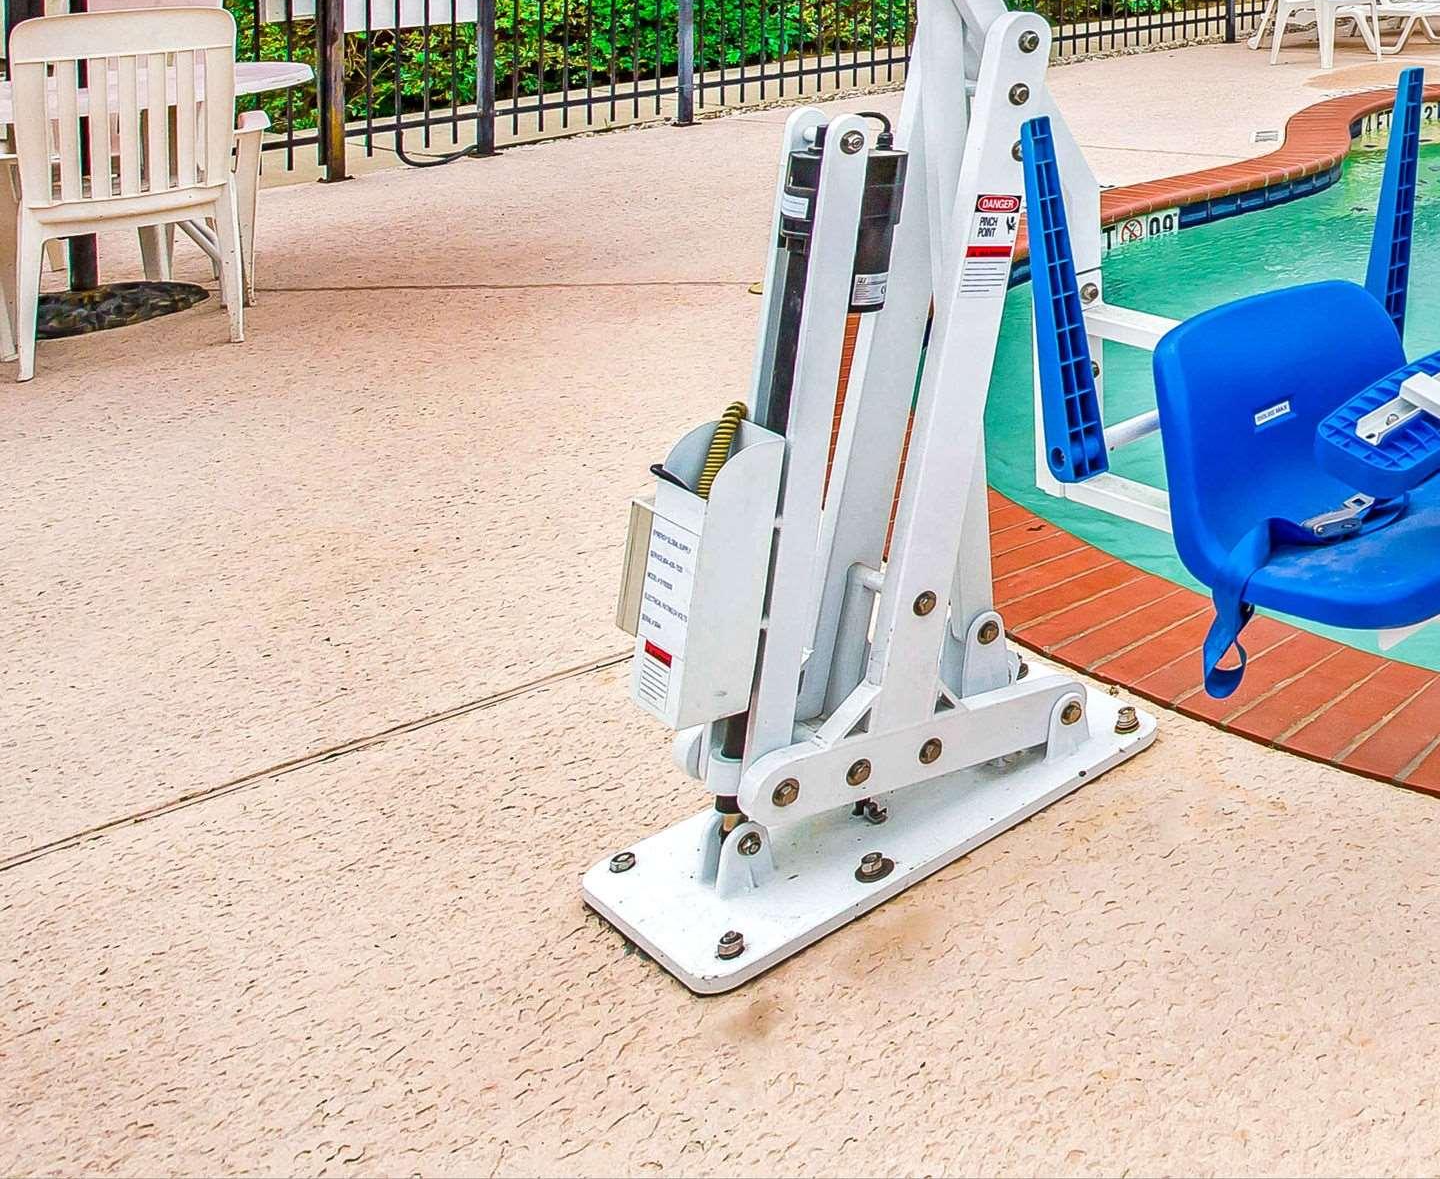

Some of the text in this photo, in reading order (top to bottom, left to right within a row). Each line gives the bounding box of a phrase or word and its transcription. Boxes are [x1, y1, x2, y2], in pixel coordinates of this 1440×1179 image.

[1377, 109, 1392, 129] FT
[982, 198, 1015, 209] DANGER
[979, 216, 998, 227] PINCH
[977, 227, 996, 238] POINT
[1102, 224, 1115, 250] T
